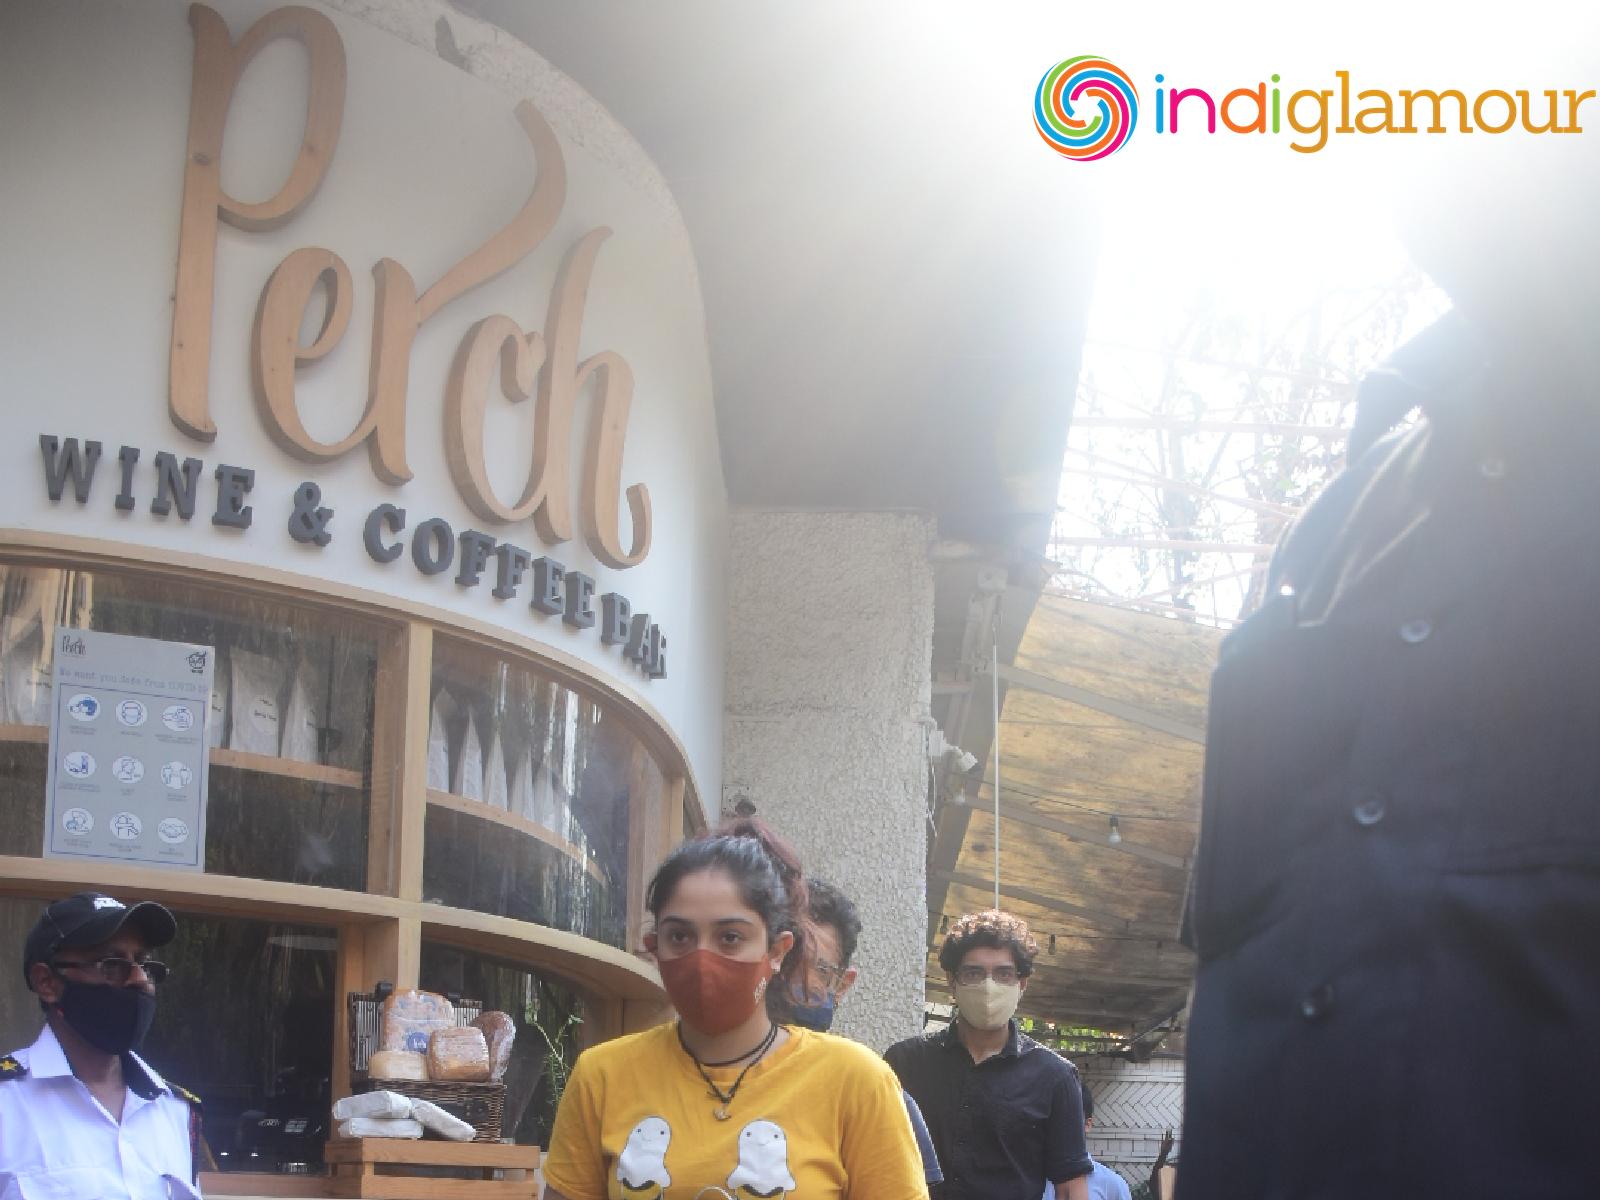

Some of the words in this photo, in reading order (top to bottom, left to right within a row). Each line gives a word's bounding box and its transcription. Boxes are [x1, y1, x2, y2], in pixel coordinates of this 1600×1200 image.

[168, 1, 652, 570] Perch
[38, 433, 255, 530] WINE
[287, 481, 335, 548] &
[362, 503, 598, 631] COFFEE
[600, 591, 669, 681] BAR
